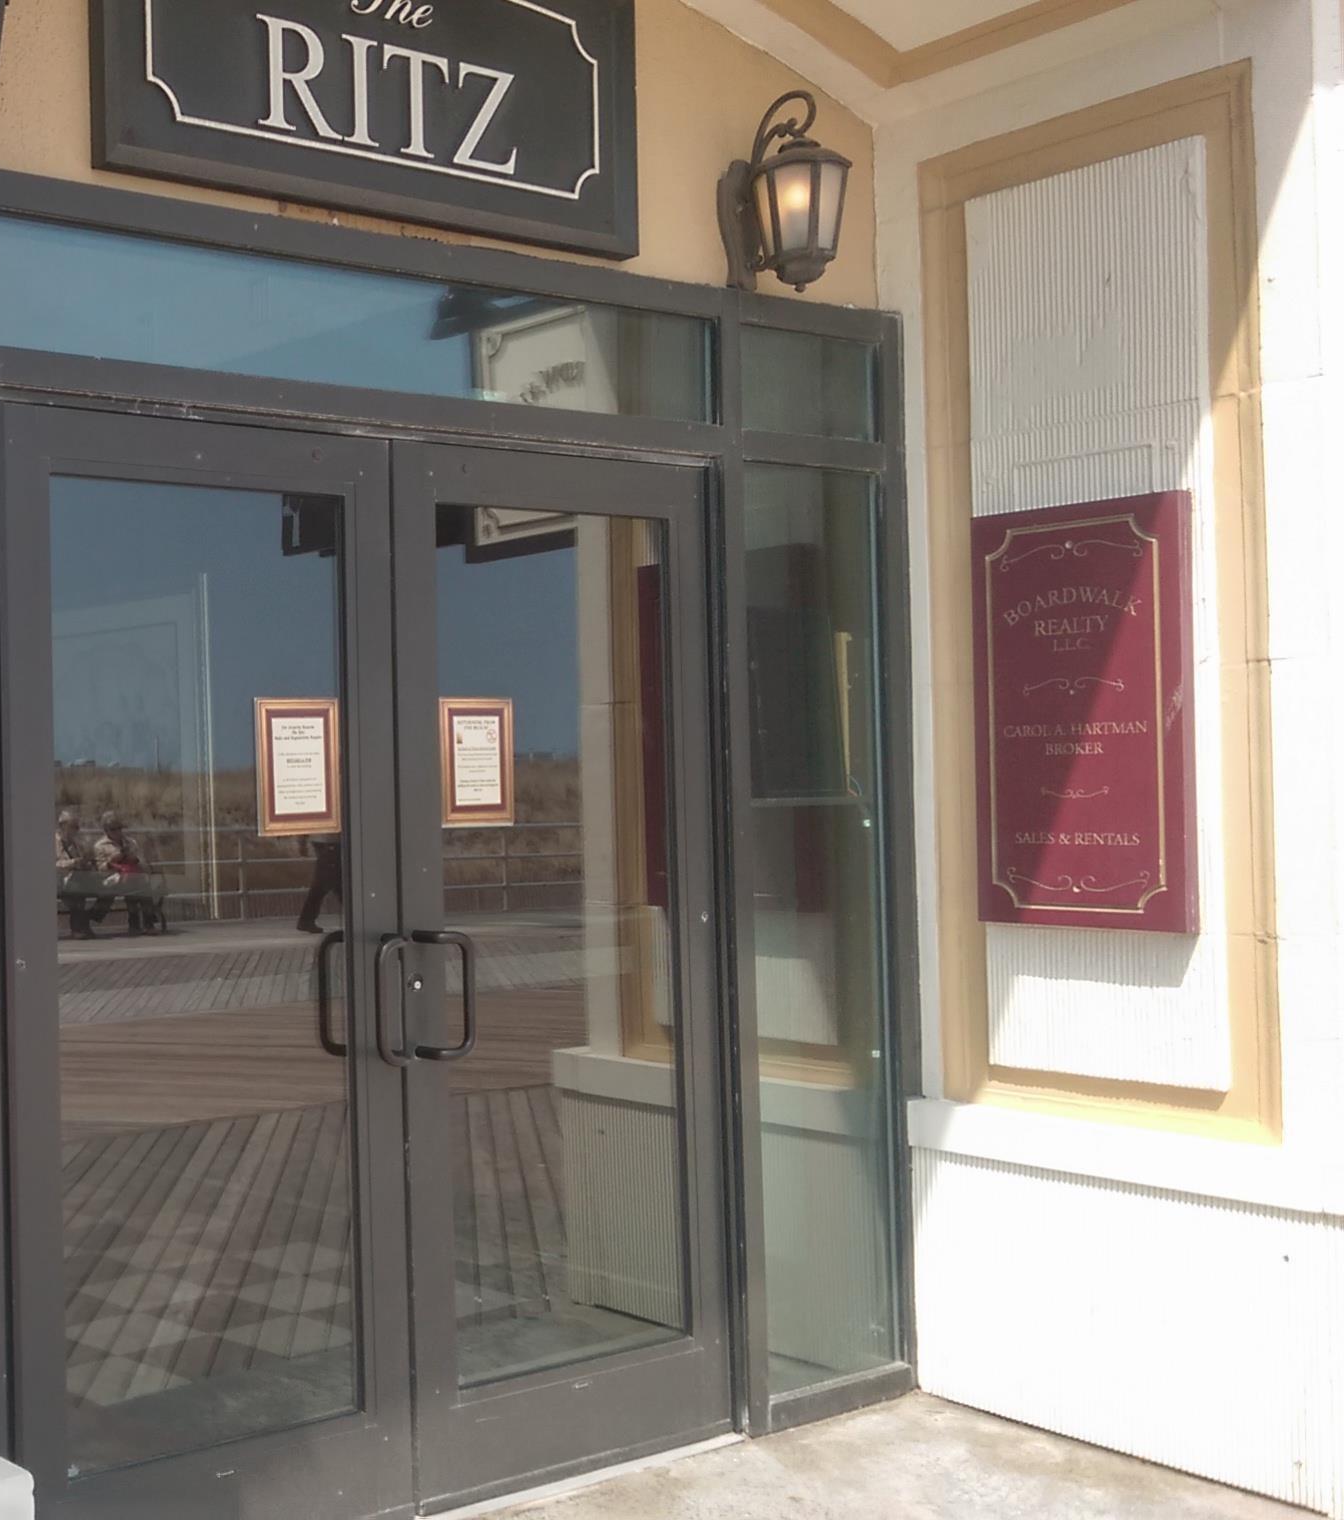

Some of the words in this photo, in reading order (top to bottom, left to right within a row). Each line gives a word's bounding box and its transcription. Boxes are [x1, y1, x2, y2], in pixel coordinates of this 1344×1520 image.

[256, 14, 518, 175] RITZ
[1003, 585, 1143, 627] BOARDWALK
[1035, 614, 1109, 637] REALTY
[1003, 724, 1051, 738] CAROL
[1071, 720, 1148, 736] HARTMAN
[1045, 742, 1104, 756] BROKER
[1015, 832, 1056, 845] SALES
[1058, 832, 1071, 845] &
[1074, 832, 1141, 846] RENTALS
